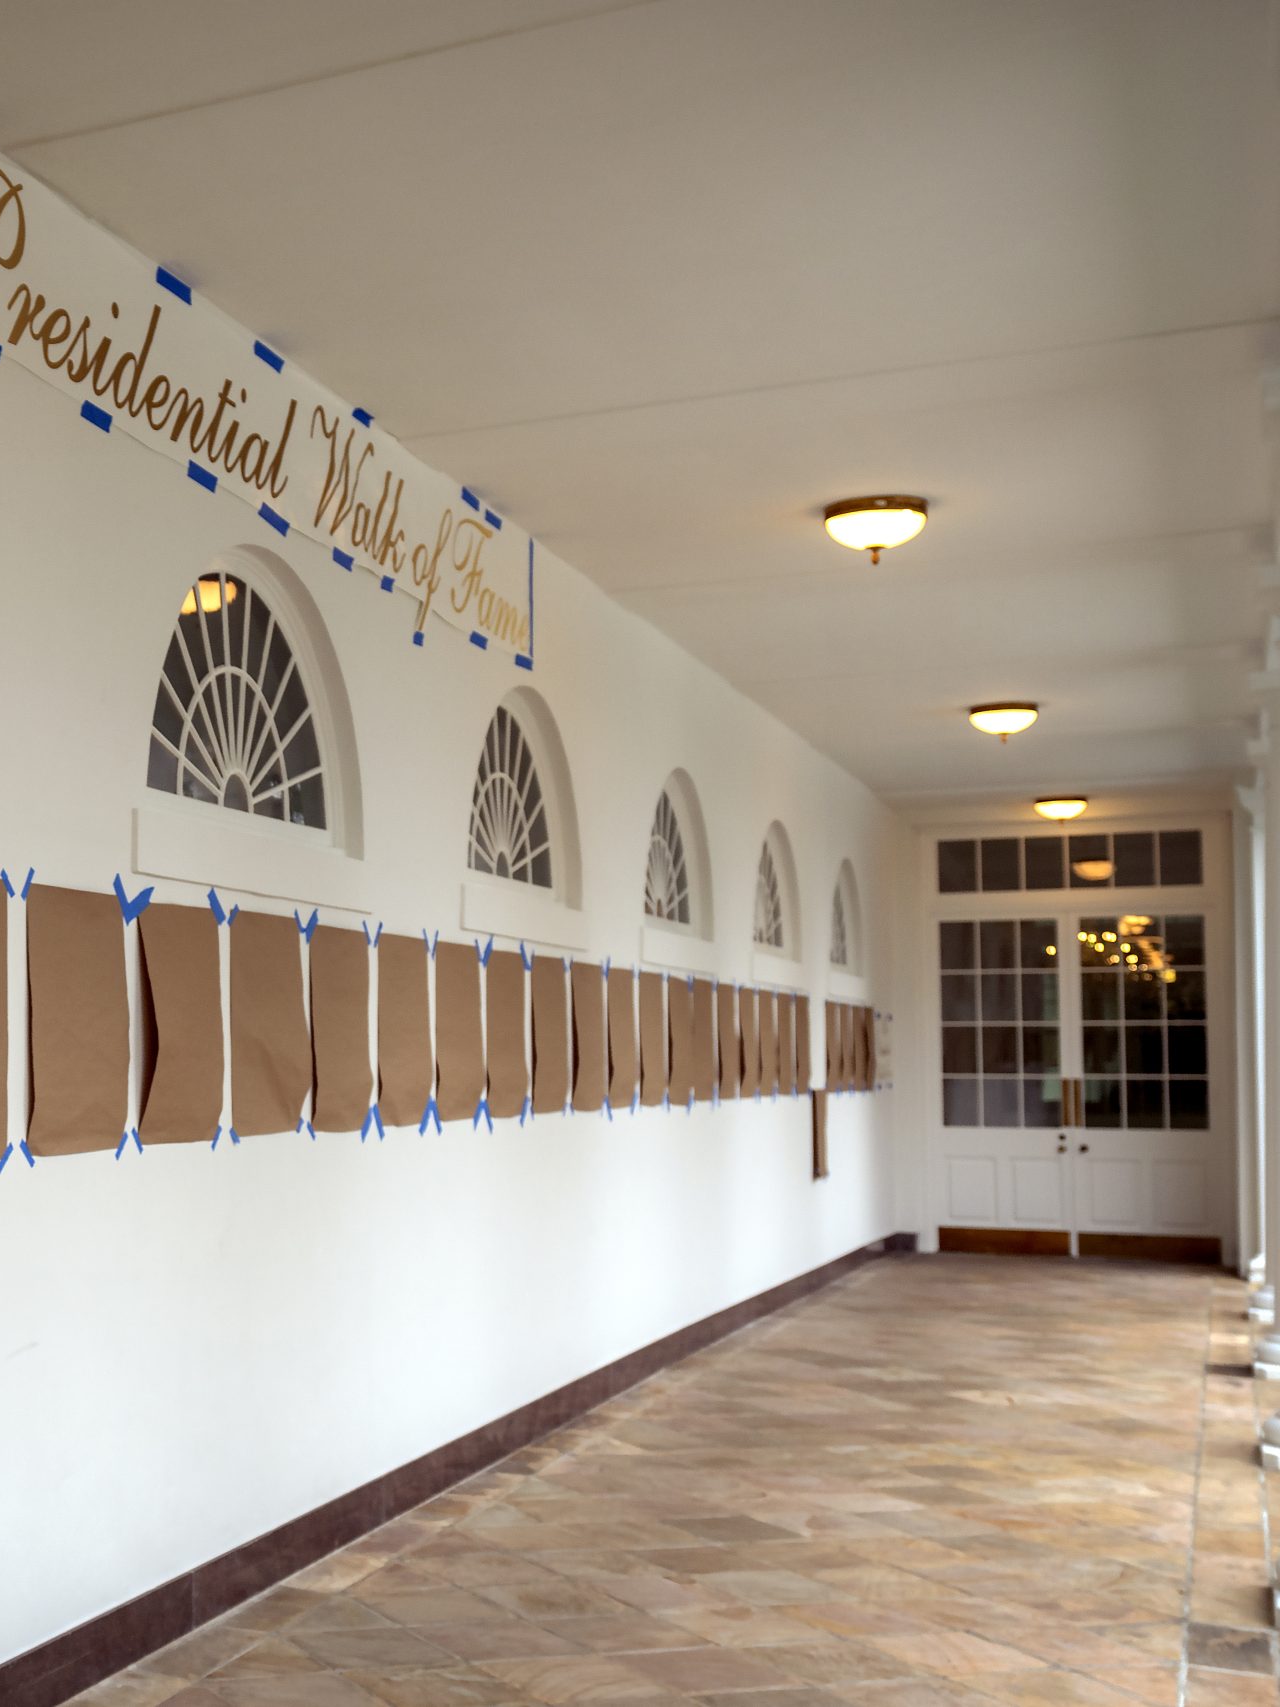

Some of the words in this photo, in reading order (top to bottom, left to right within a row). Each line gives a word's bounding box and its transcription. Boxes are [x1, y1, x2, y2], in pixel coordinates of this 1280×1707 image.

[310, 404, 406, 574] Walk
[412, 508, 454, 631] of
[451, 518, 529, 652] Fame
